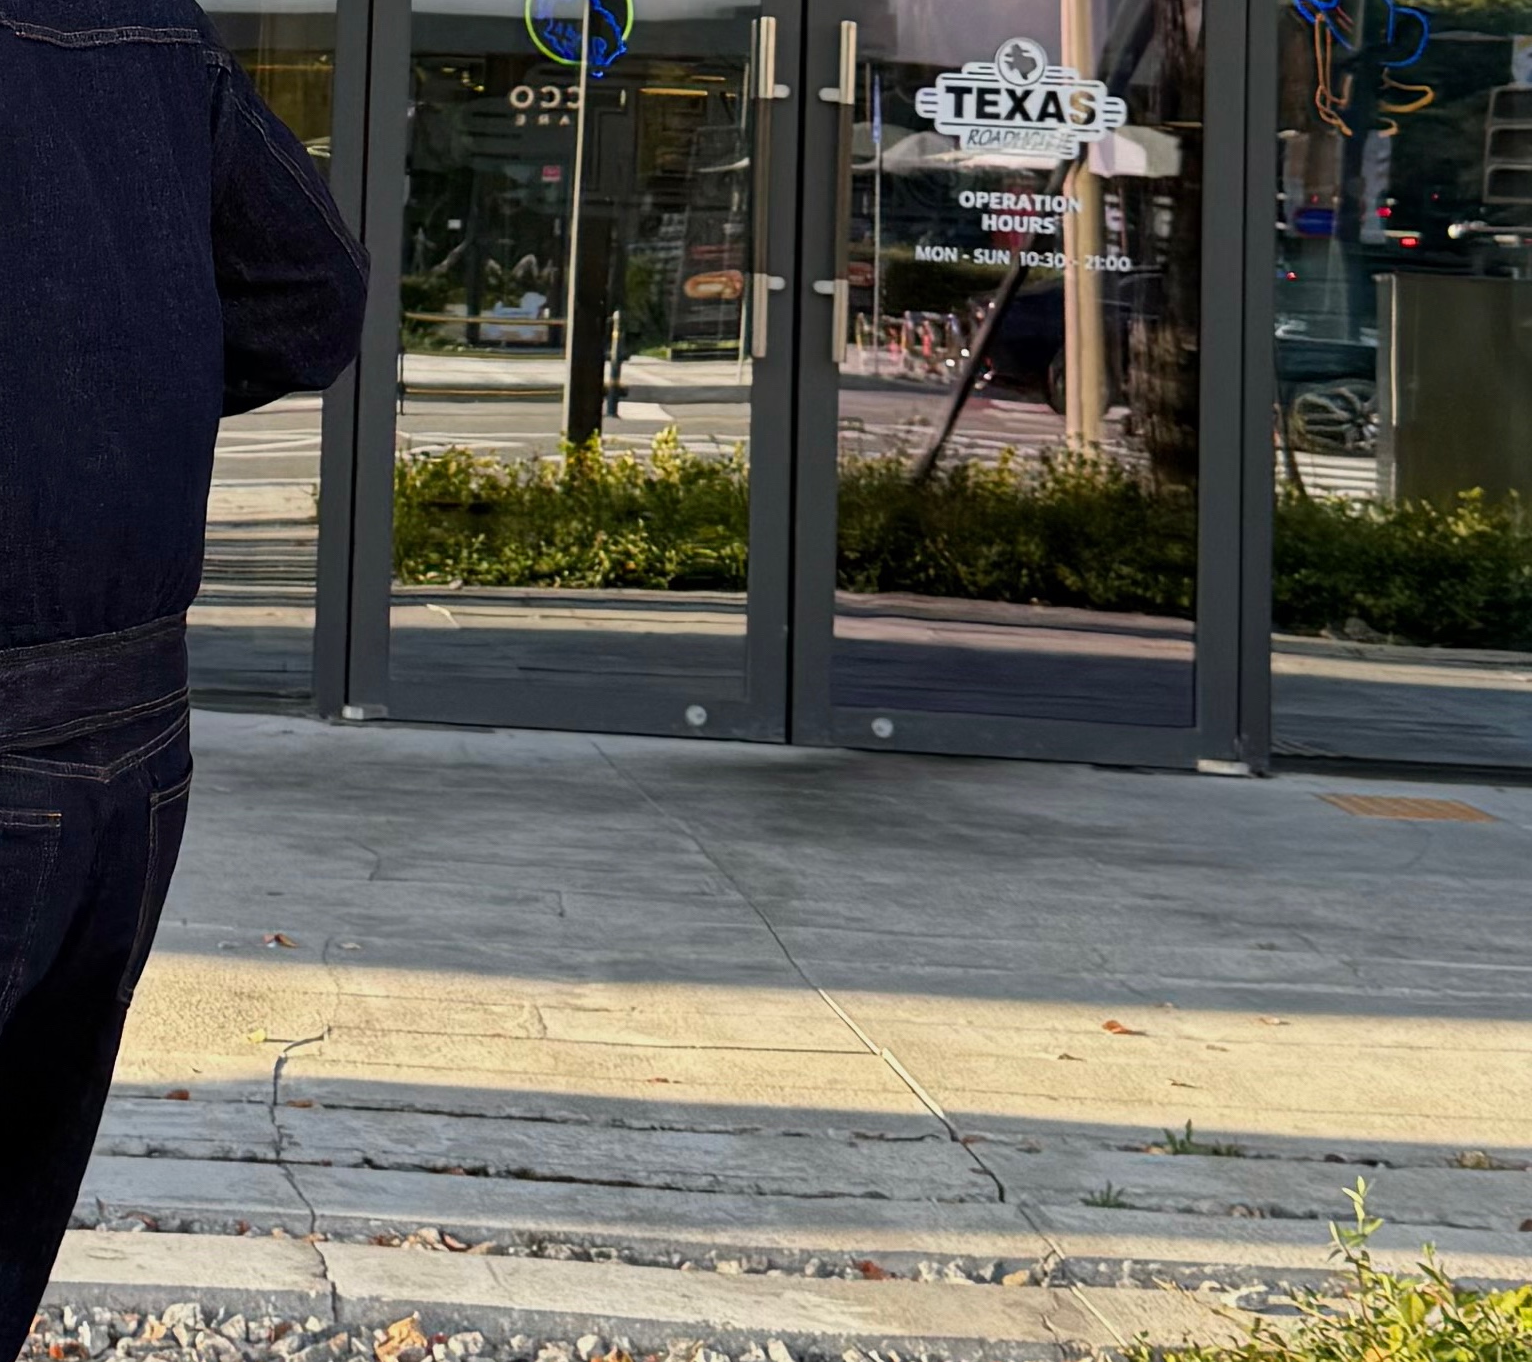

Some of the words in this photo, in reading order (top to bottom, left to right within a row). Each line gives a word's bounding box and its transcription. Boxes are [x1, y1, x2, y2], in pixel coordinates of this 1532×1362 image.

[944, 85, 1098, 126] TEXAS
[959, 190, 1083, 214] OPERATION
[982, 214, 1056, 234] HOURS
[915, 245, 958, 262] MON
[973, 248, 1011, 265] SUN
[1019, 251, 1065, 269] 10:30
[1084, 254, 1131, 272] 21:00
